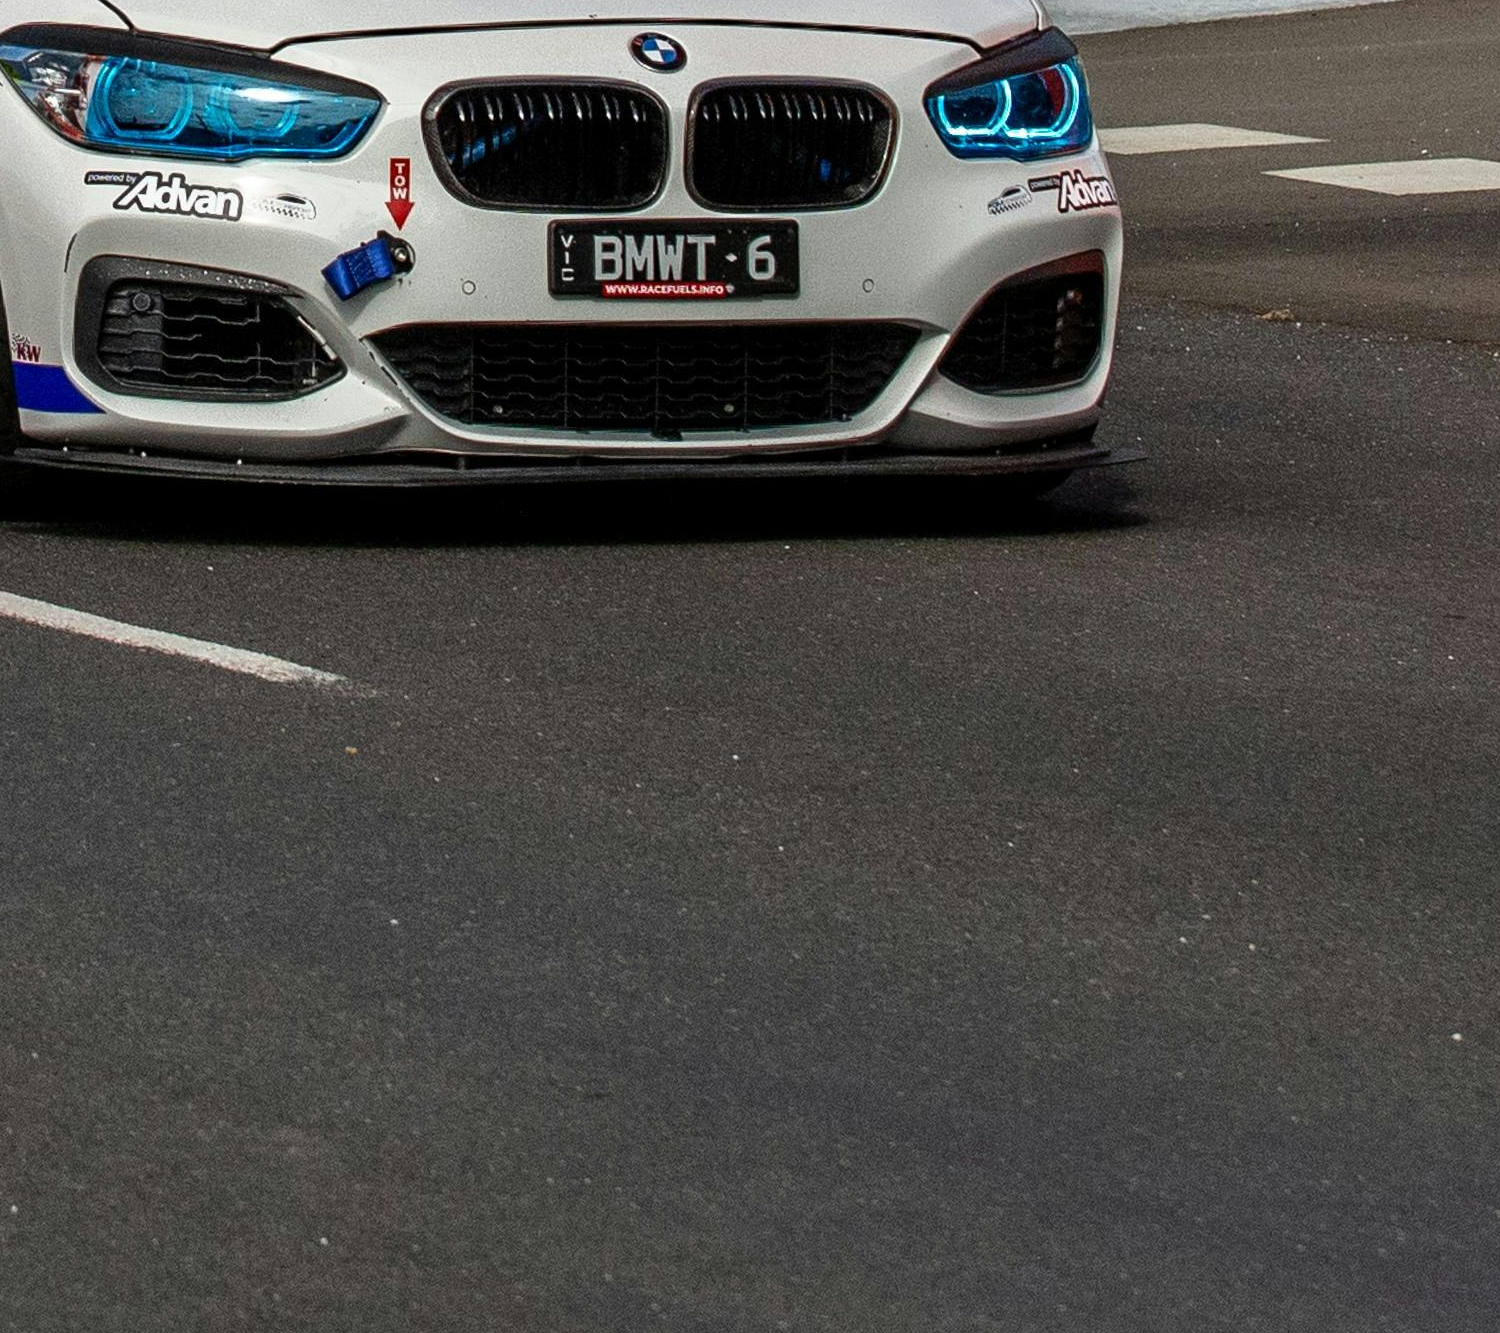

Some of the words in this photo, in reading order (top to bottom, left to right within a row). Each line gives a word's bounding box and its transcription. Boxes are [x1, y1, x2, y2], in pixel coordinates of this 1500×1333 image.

[116, 174, 240, 218] Advan
[394, 162, 408, 200] TOW
[1059, 170, 1115, 211] Advan
[560, 235, 577, 282] VIC
[593, 235, 716, 281] BMWT
[746, 235, 776, 281] 6
[605, 284, 725, 295] WWW.RACEFUELS.INFO
